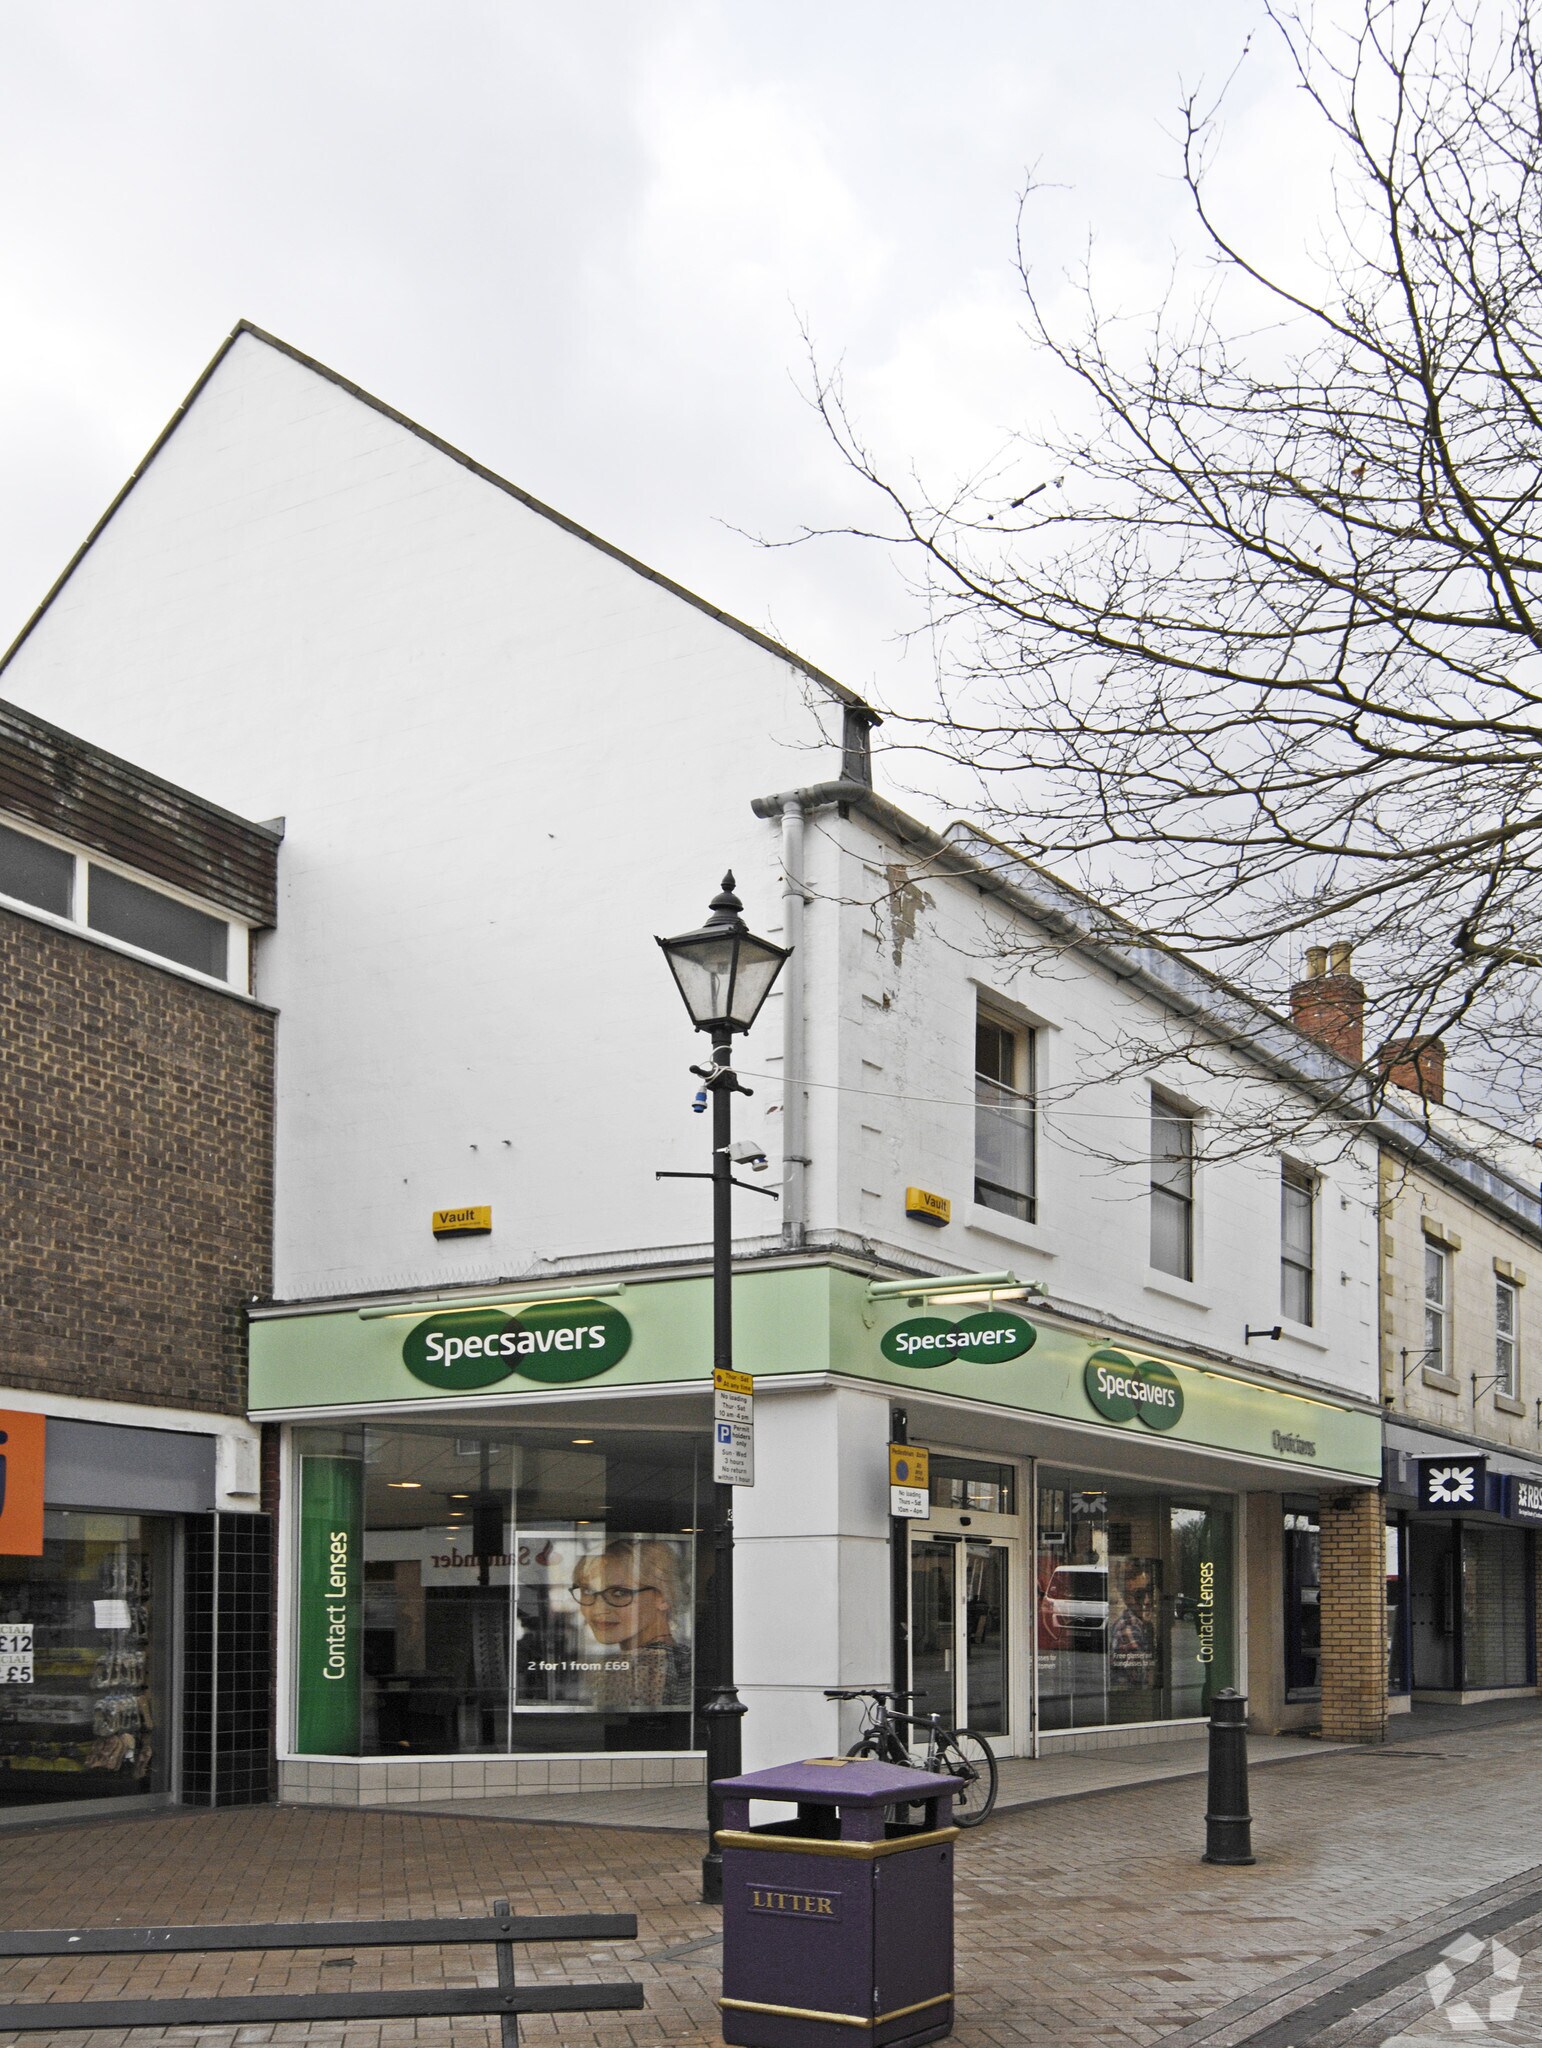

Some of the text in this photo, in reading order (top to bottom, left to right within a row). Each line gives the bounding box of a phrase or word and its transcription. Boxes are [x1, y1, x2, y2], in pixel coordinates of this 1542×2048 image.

[924, 1193, 947, 1212] Vault
[439, 1210, 475, 1223] Vault
[425, 1325, 606, 1367] Specsavers
[895, 1328, 1017, 1355] Specsavers
[1097, 1367, 1176, 1408] Specsavers
[729, 1395, 747, 1404] loading
[720, 1426, 730, 1442] P
[733, 1424, 750, 1433] Permit
[1272, 1429, 1316, 1457] Opticians
[323, 1531, 348, 1680] Contact Lenses
[1196, 1562, 1214, 1663] Contact Lenses
[0, 1636, 32, 1652] £12
[7, 1666, 31, 1682] £5
[527, 1661, 630, 1671] 2 for 1 from £69
[753, 1891, 834, 1914] LITTER
